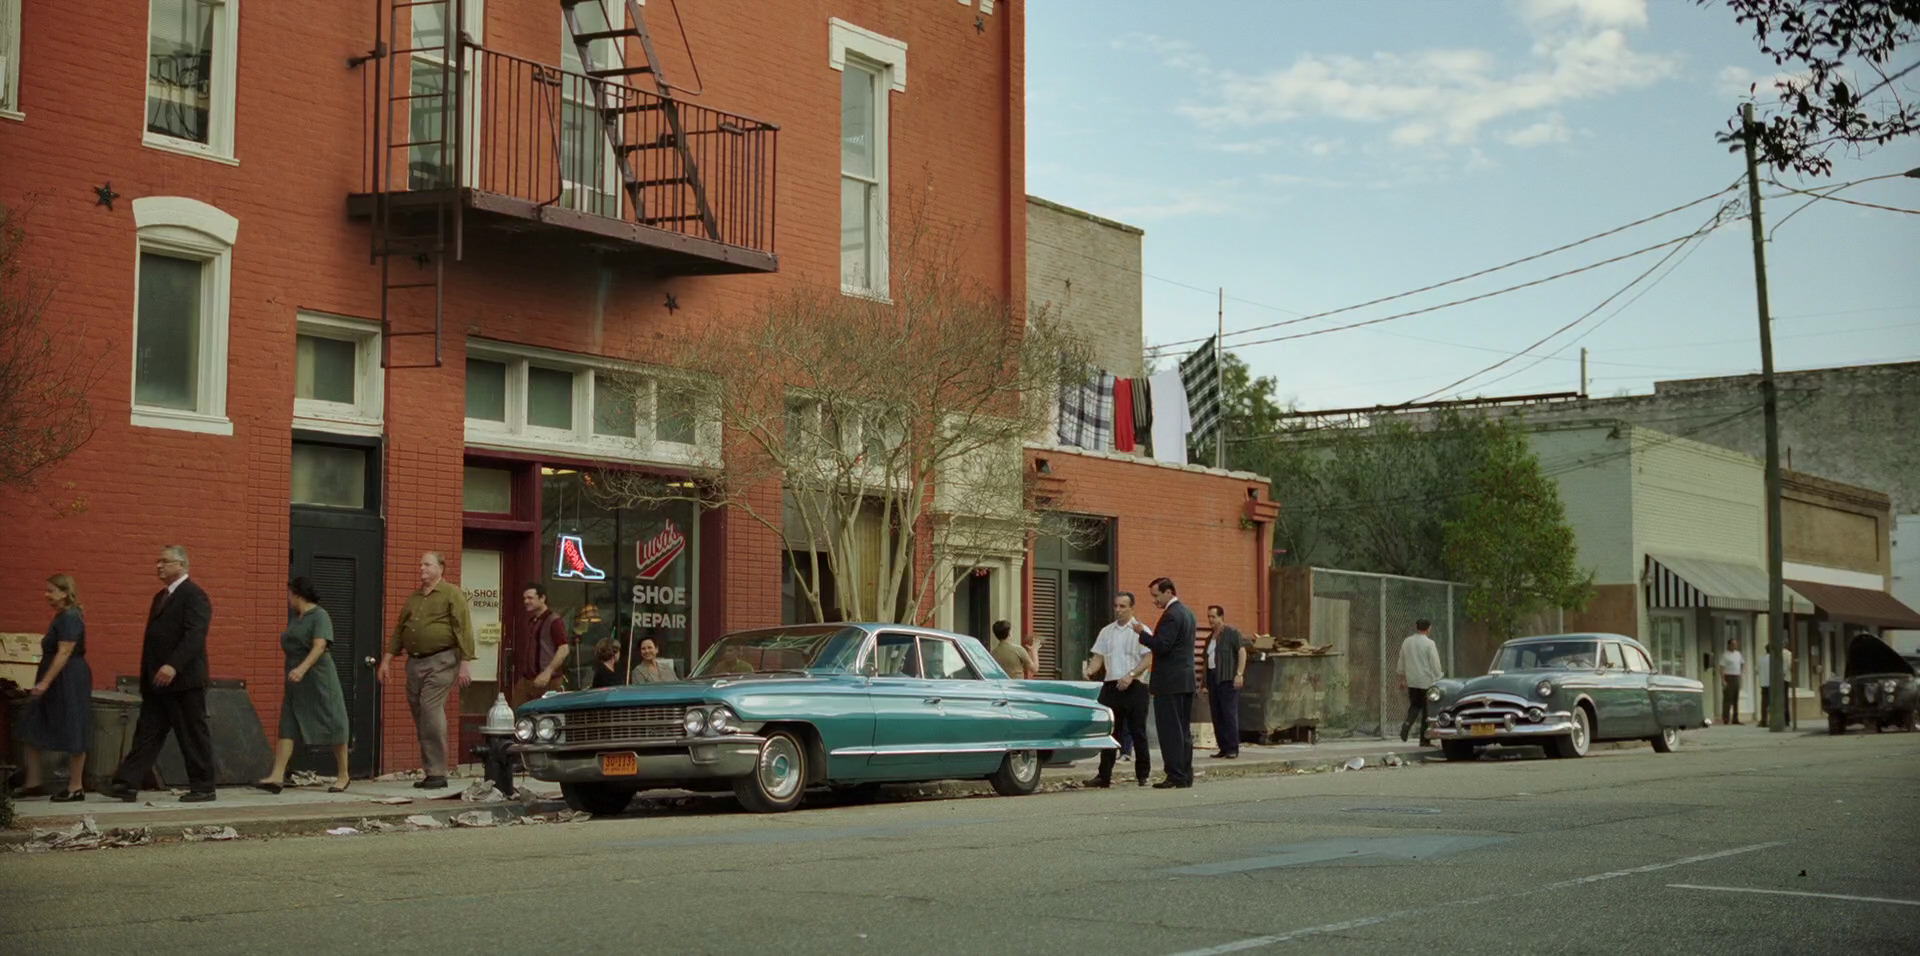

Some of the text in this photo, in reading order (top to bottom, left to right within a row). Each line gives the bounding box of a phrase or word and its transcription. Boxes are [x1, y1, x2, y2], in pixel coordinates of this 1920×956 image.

[564, 539, 585, 572] REPAIR
[473, 589, 498, 598] SHOE
[632, 585, 686, 605] SHOE
[473, 600, 499, 608] REPAIR
[632, 612, 687, 629] REPAIR
